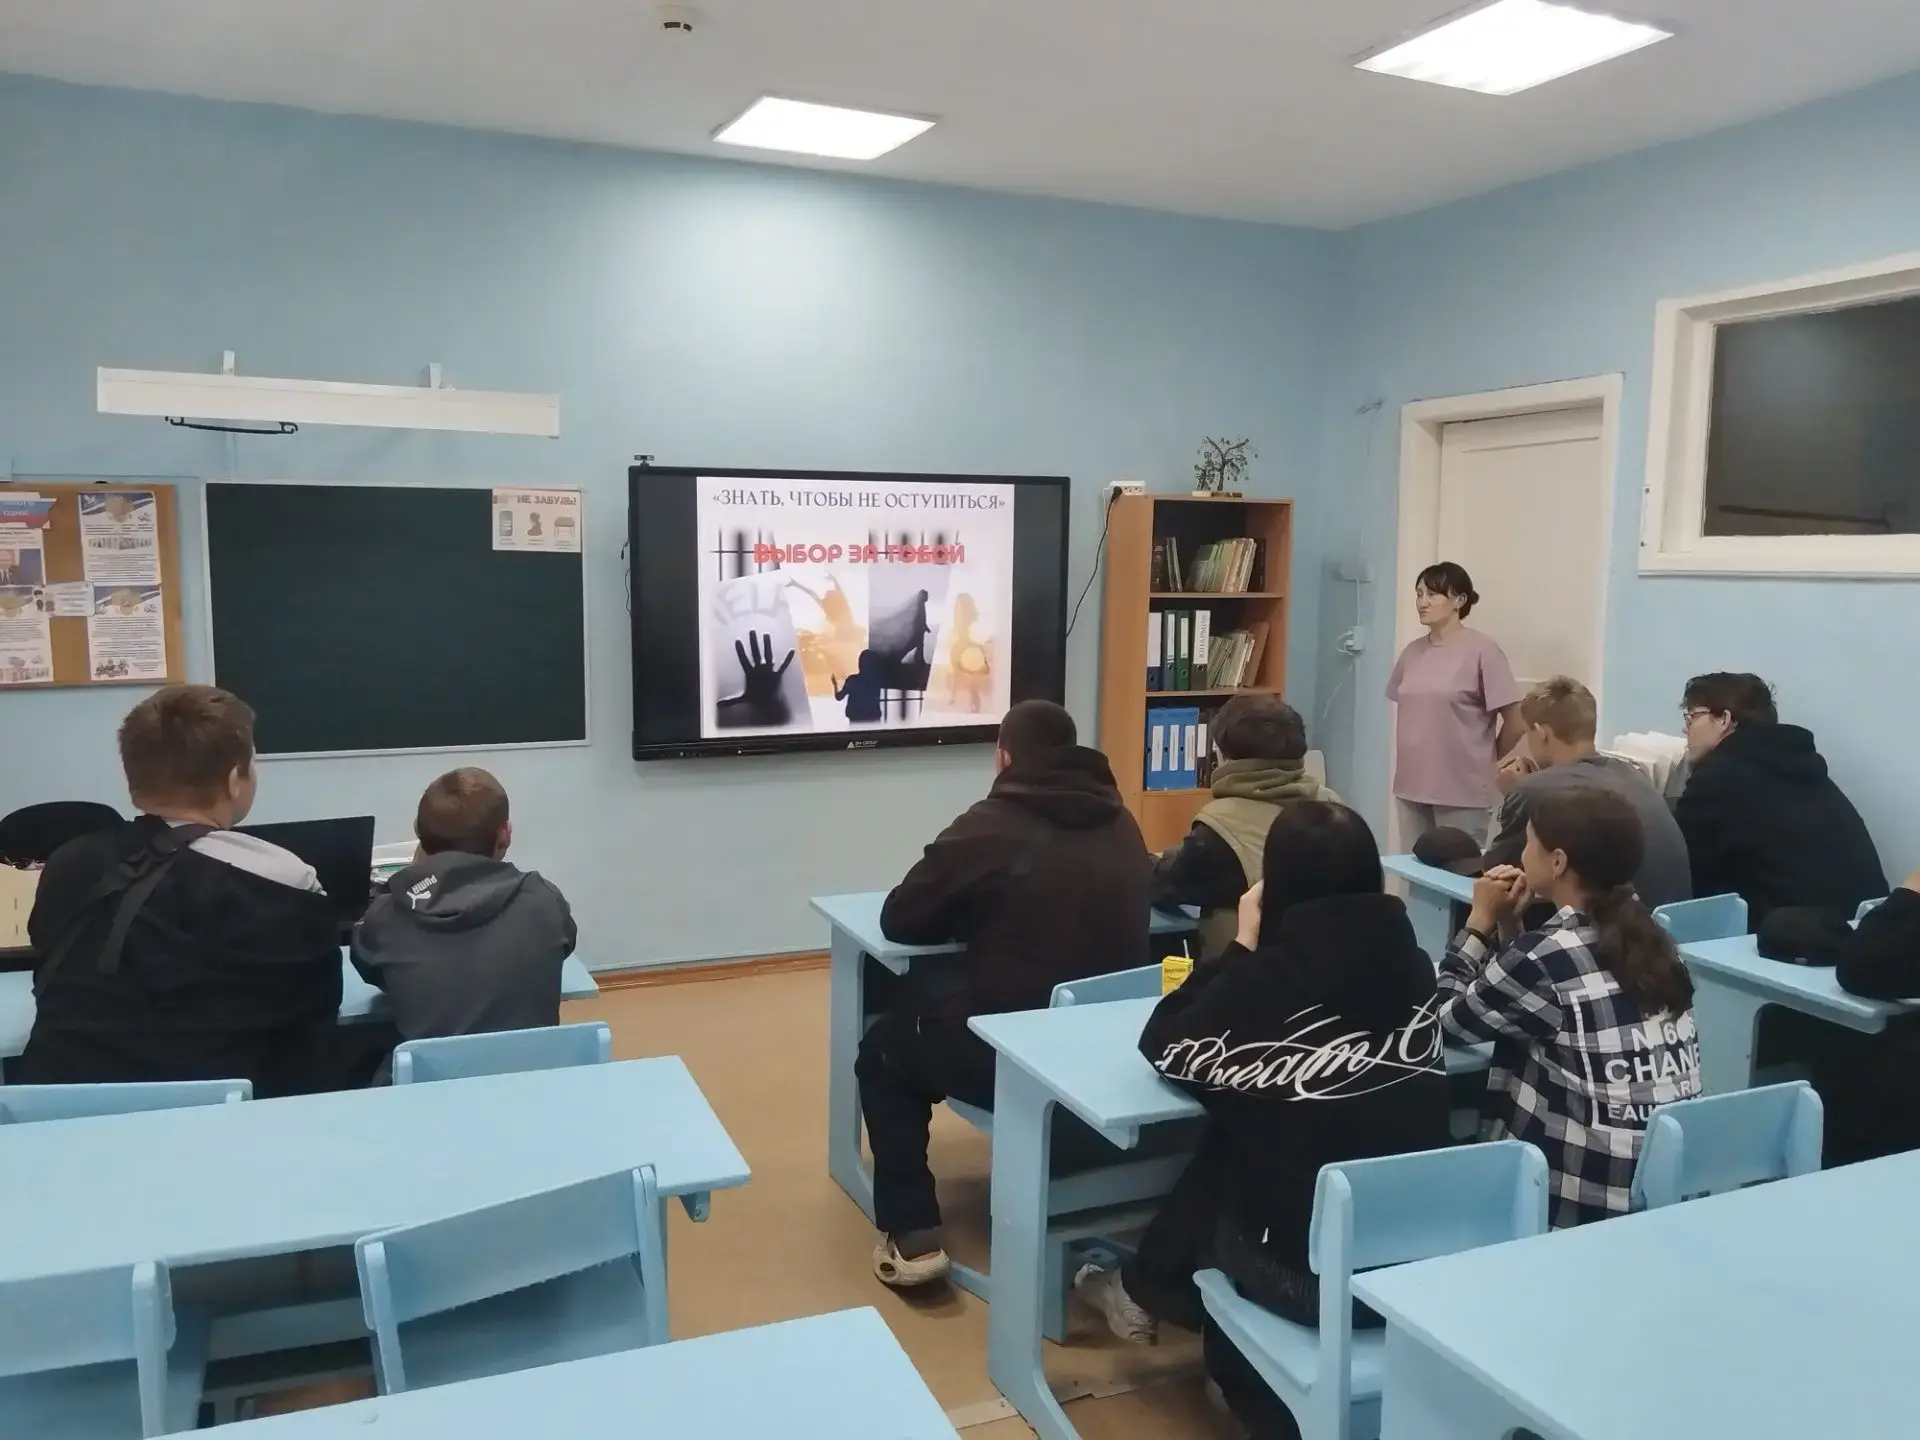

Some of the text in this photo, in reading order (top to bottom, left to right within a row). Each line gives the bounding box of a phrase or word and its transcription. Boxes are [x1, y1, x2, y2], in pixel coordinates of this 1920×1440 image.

[713, 489, 1006, 509] «ЗНАТЬ, ЧТОБЫ НЕ ОСТУПИТЬСЯ»
[753, 542, 966, 565] ВЫБОР ЗА ТОБОЙ
[411, 874, 438, 895] PUMA
